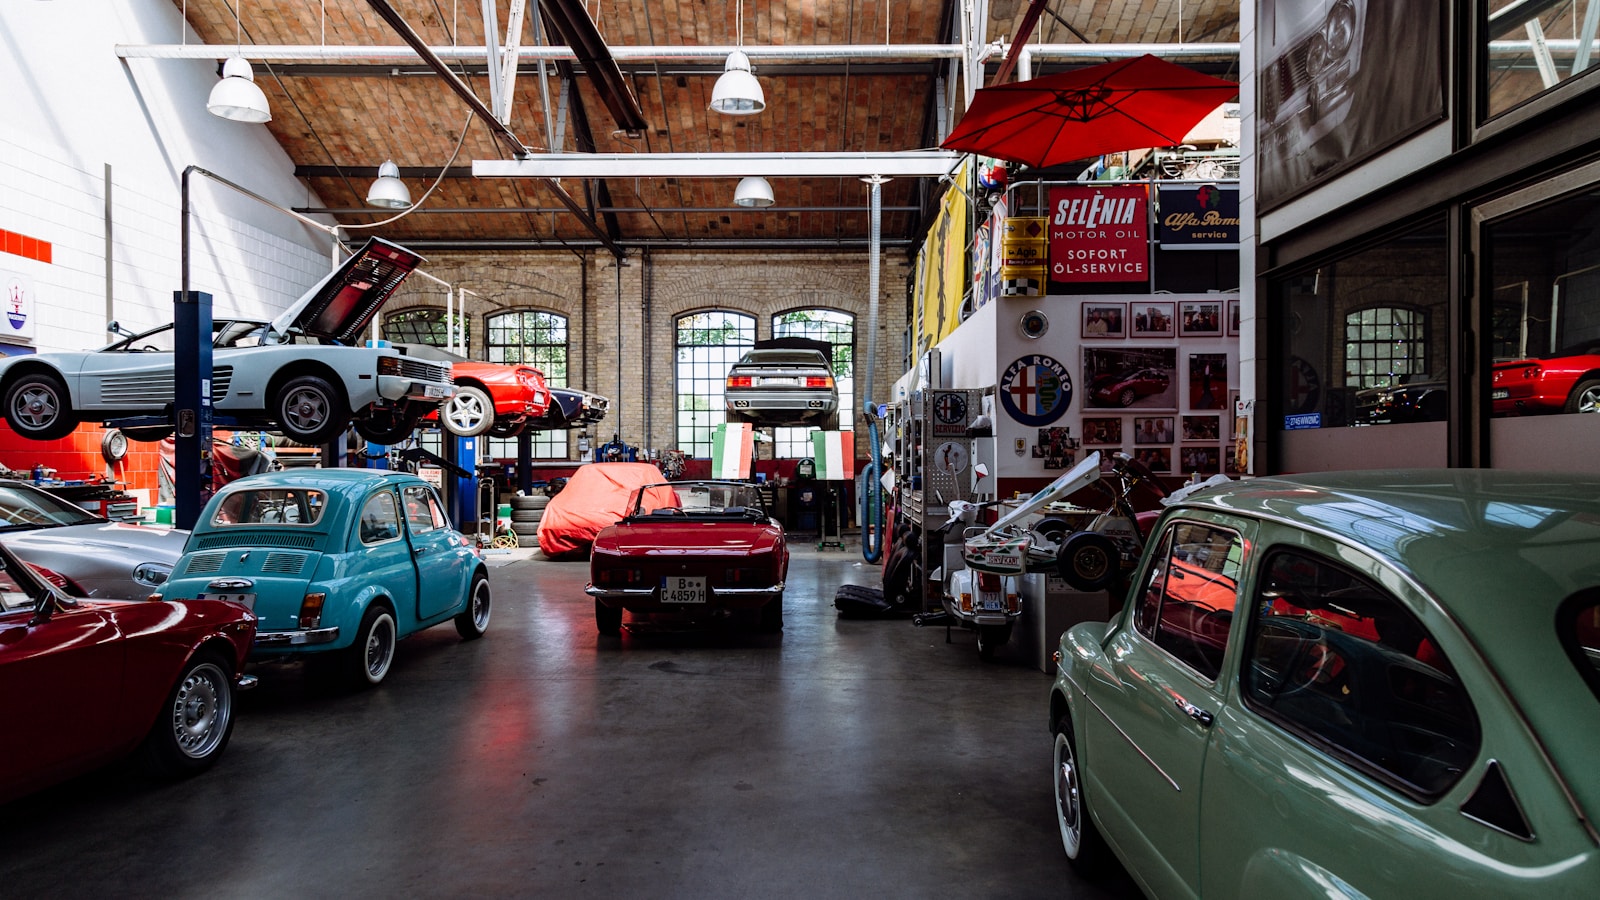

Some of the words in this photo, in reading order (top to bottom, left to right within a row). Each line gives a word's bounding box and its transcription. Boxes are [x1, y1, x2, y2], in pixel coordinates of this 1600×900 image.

[1054, 190, 1138, 229] SELÈNIA
[1164, 211, 1201, 232] Alfa
[1054, 231, 1107, 240] MOTOR
[1115, 230, 1140, 239] OIL
[1191, 230, 1228, 239] service
[1016, 247, 1037, 257] Agip
[1068, 249, 1127, 260] SOFORT
[1054, 262, 1143, 274] ÖL-SERVICE
[1001, 359, 1027, 393] ALFA
[1033, 355, 1071, 392] ROMEO
[935, 424, 966, 434] SERVIZIO
[679, 578, 686, 589] B
[662, 590, 668, 601] C
[671, 590, 696, 601] 4859
[698, 590, 705, 601] H
